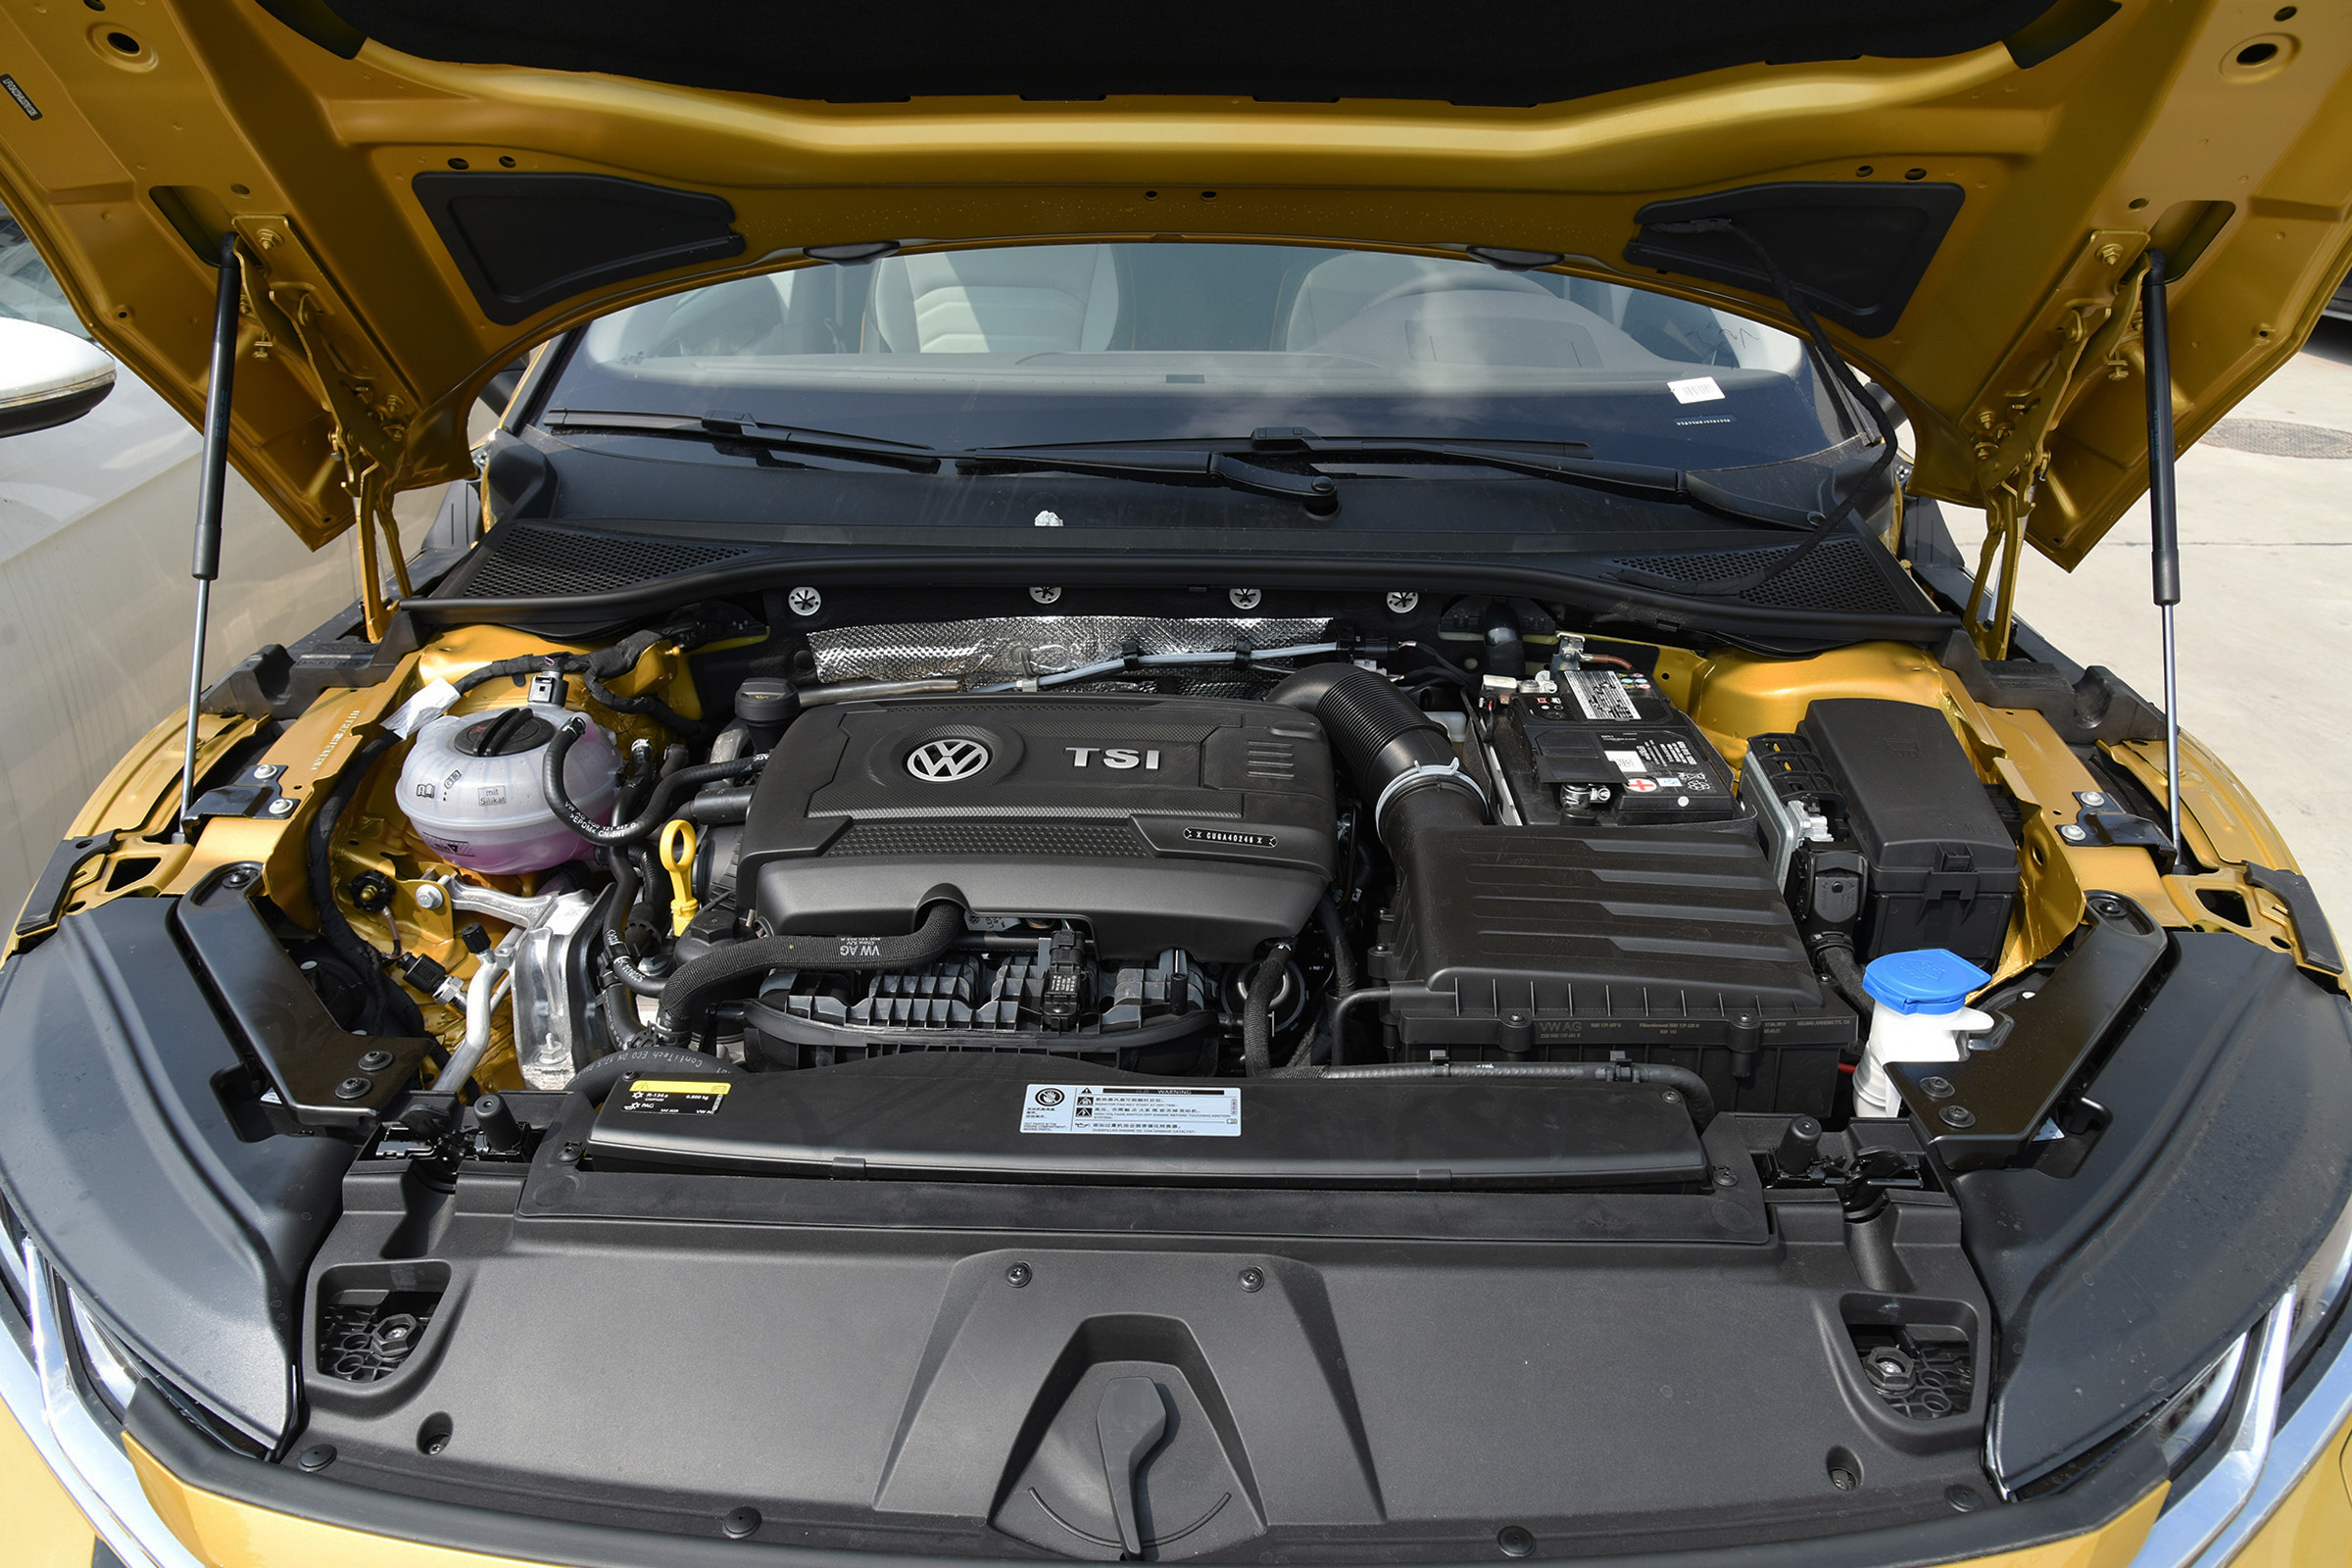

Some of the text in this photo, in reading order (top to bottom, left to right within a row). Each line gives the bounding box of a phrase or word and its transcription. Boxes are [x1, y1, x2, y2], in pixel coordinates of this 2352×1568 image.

[1065, 747, 1161, 770] TSI
[445, 770, 462, 788] G13
[480, 797, 506, 806] Silikat
[840, 945, 880, 956] VW AG
[1540, 1021, 1582, 1032] VW AG
[631, 1051, 648, 1059] ECO
